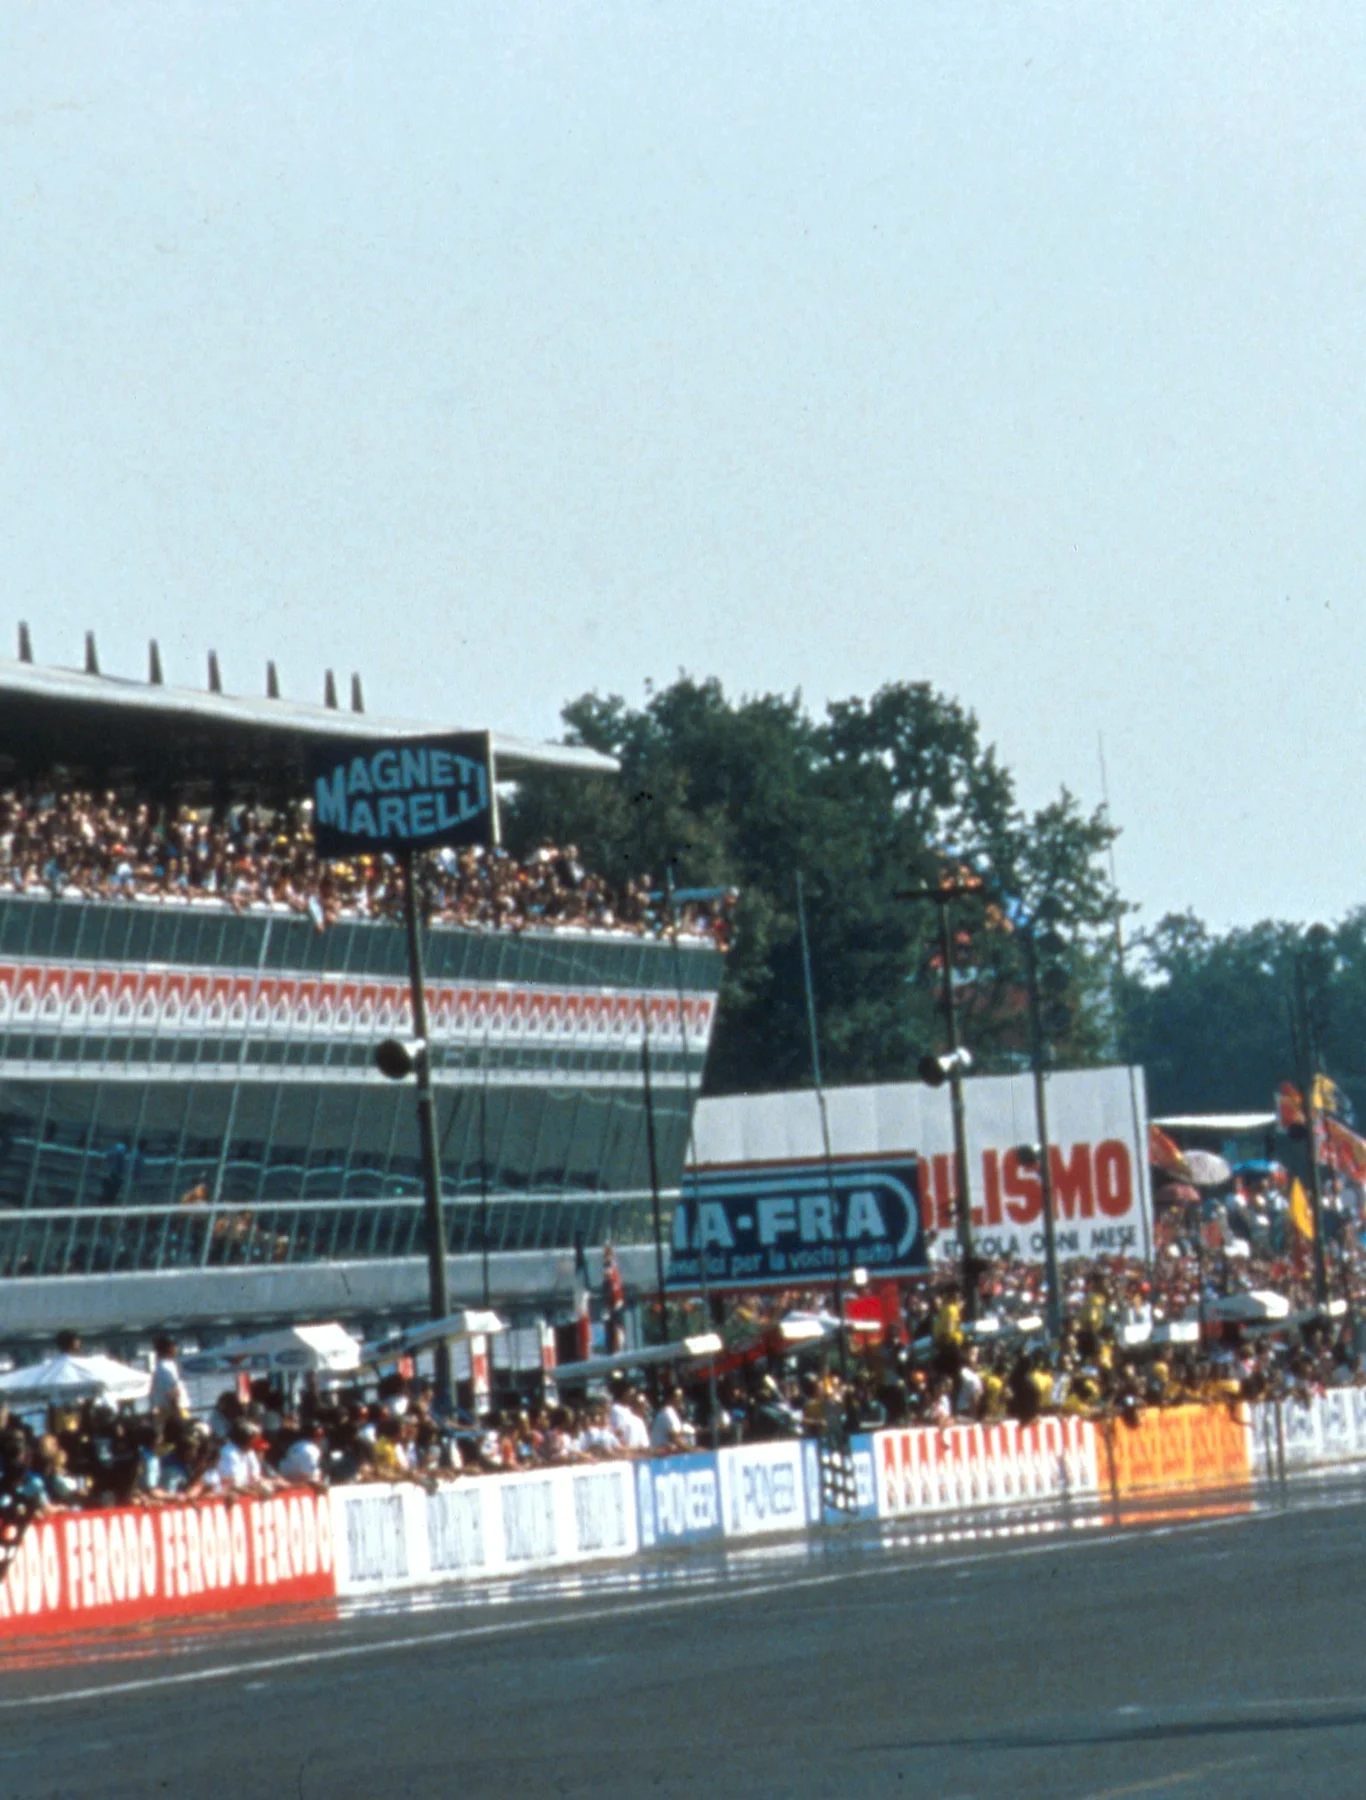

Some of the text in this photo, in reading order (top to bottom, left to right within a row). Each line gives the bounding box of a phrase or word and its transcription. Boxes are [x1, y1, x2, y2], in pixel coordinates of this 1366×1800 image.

[316, 748, 489, 818] MAGNETI
[316, 774, 488, 838] MARELLI
[1029, 1230, 1079, 1254] ONI
[64, 1513, 157, 1609] FERODO
[159, 1503, 247, 1598] FERODO
[250, 1495, 333, 1586] FERODO
